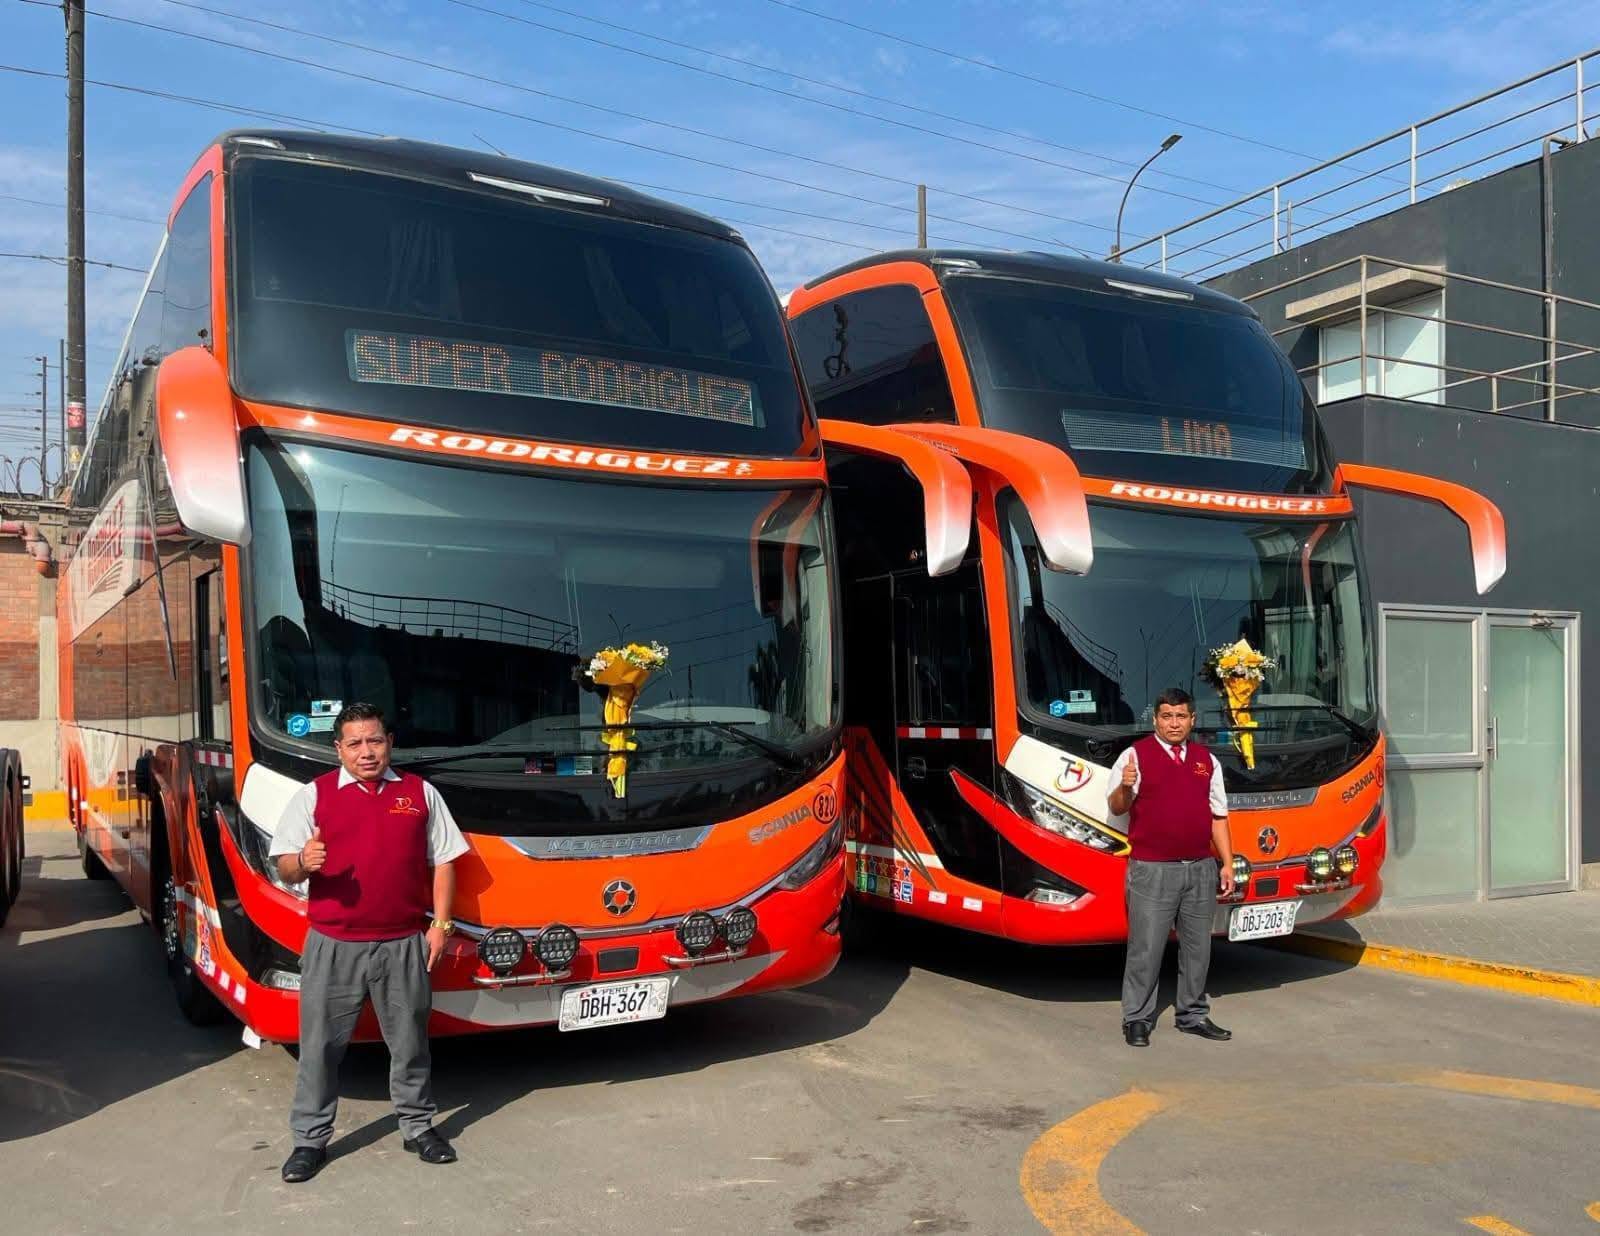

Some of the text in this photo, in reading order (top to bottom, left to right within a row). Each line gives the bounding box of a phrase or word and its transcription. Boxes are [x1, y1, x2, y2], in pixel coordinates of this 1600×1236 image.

[357, 334, 752, 425] SUPER RODRIGUEZ
[388, 427, 729, 475] RODRIGUEZ
[1161, 415, 1232, 459] LIMA
[1110, 480, 1314, 512] RODRIGUEZ
[1342, 769, 1376, 804] SCANIA
[749, 804, 812, 844] SCANIA
[1242, 911, 1284, 933] DBJ-203
[580, 990, 649, 1019] DBH-367
